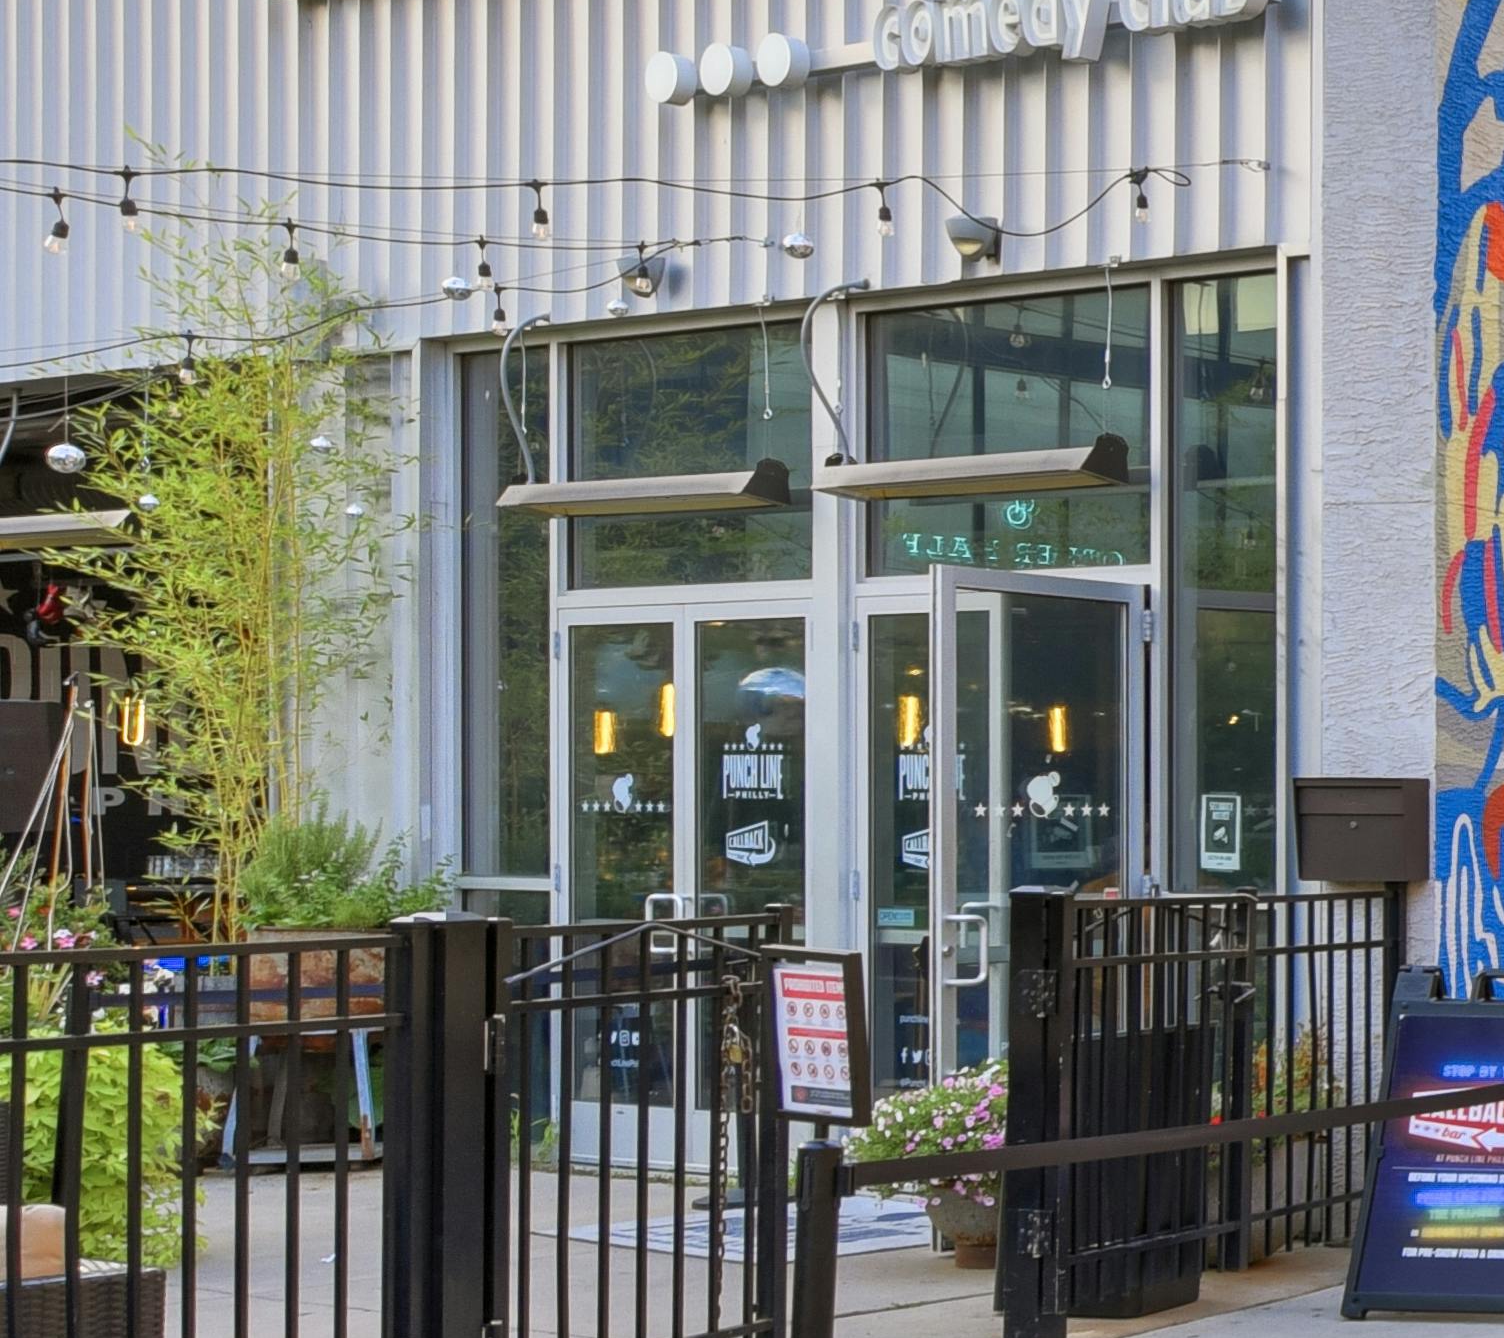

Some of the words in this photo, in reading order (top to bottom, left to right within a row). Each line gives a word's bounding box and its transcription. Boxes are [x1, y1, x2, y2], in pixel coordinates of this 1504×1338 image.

[723, 754, 758, 799] PUNCH
[760, 754, 784, 799] LINE
[899, 754, 930, 801] PUNC
[735, 791, 770, 799] PHILLY
[729, 828, 764, 850] CALLBACK
[1442, 1064, 1476, 1079] STOP
[1479, 1065, 1498, 1079] BY
[1441, 1126, 1468, 1140] bar
